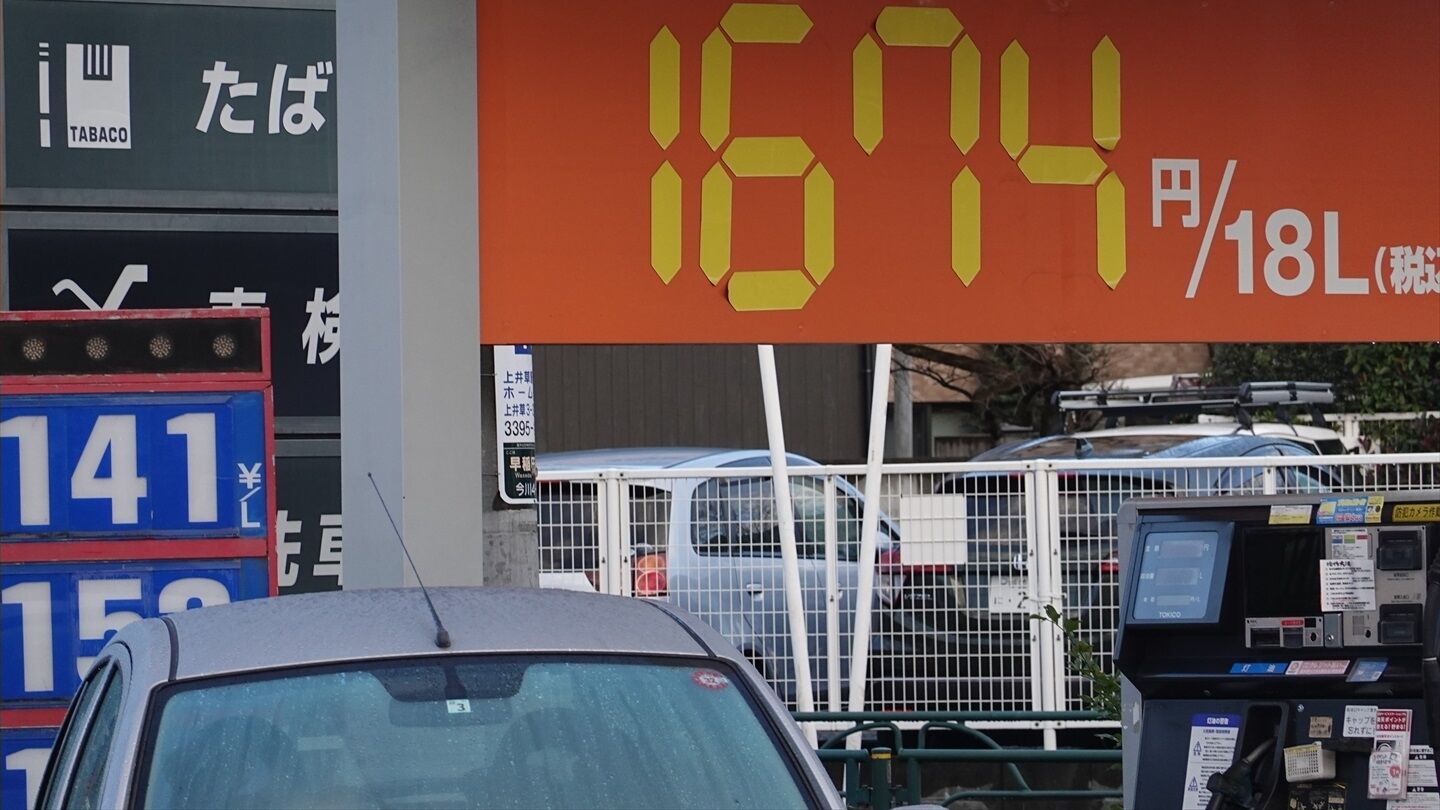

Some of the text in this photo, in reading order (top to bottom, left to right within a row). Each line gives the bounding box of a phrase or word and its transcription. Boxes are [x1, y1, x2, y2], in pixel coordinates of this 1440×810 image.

[70, 125, 128, 143] TABACO
[195, 60, 334, 136] たば
[650, 3, 1126, 312] 1674
[0, 413, 218, 526] 141
